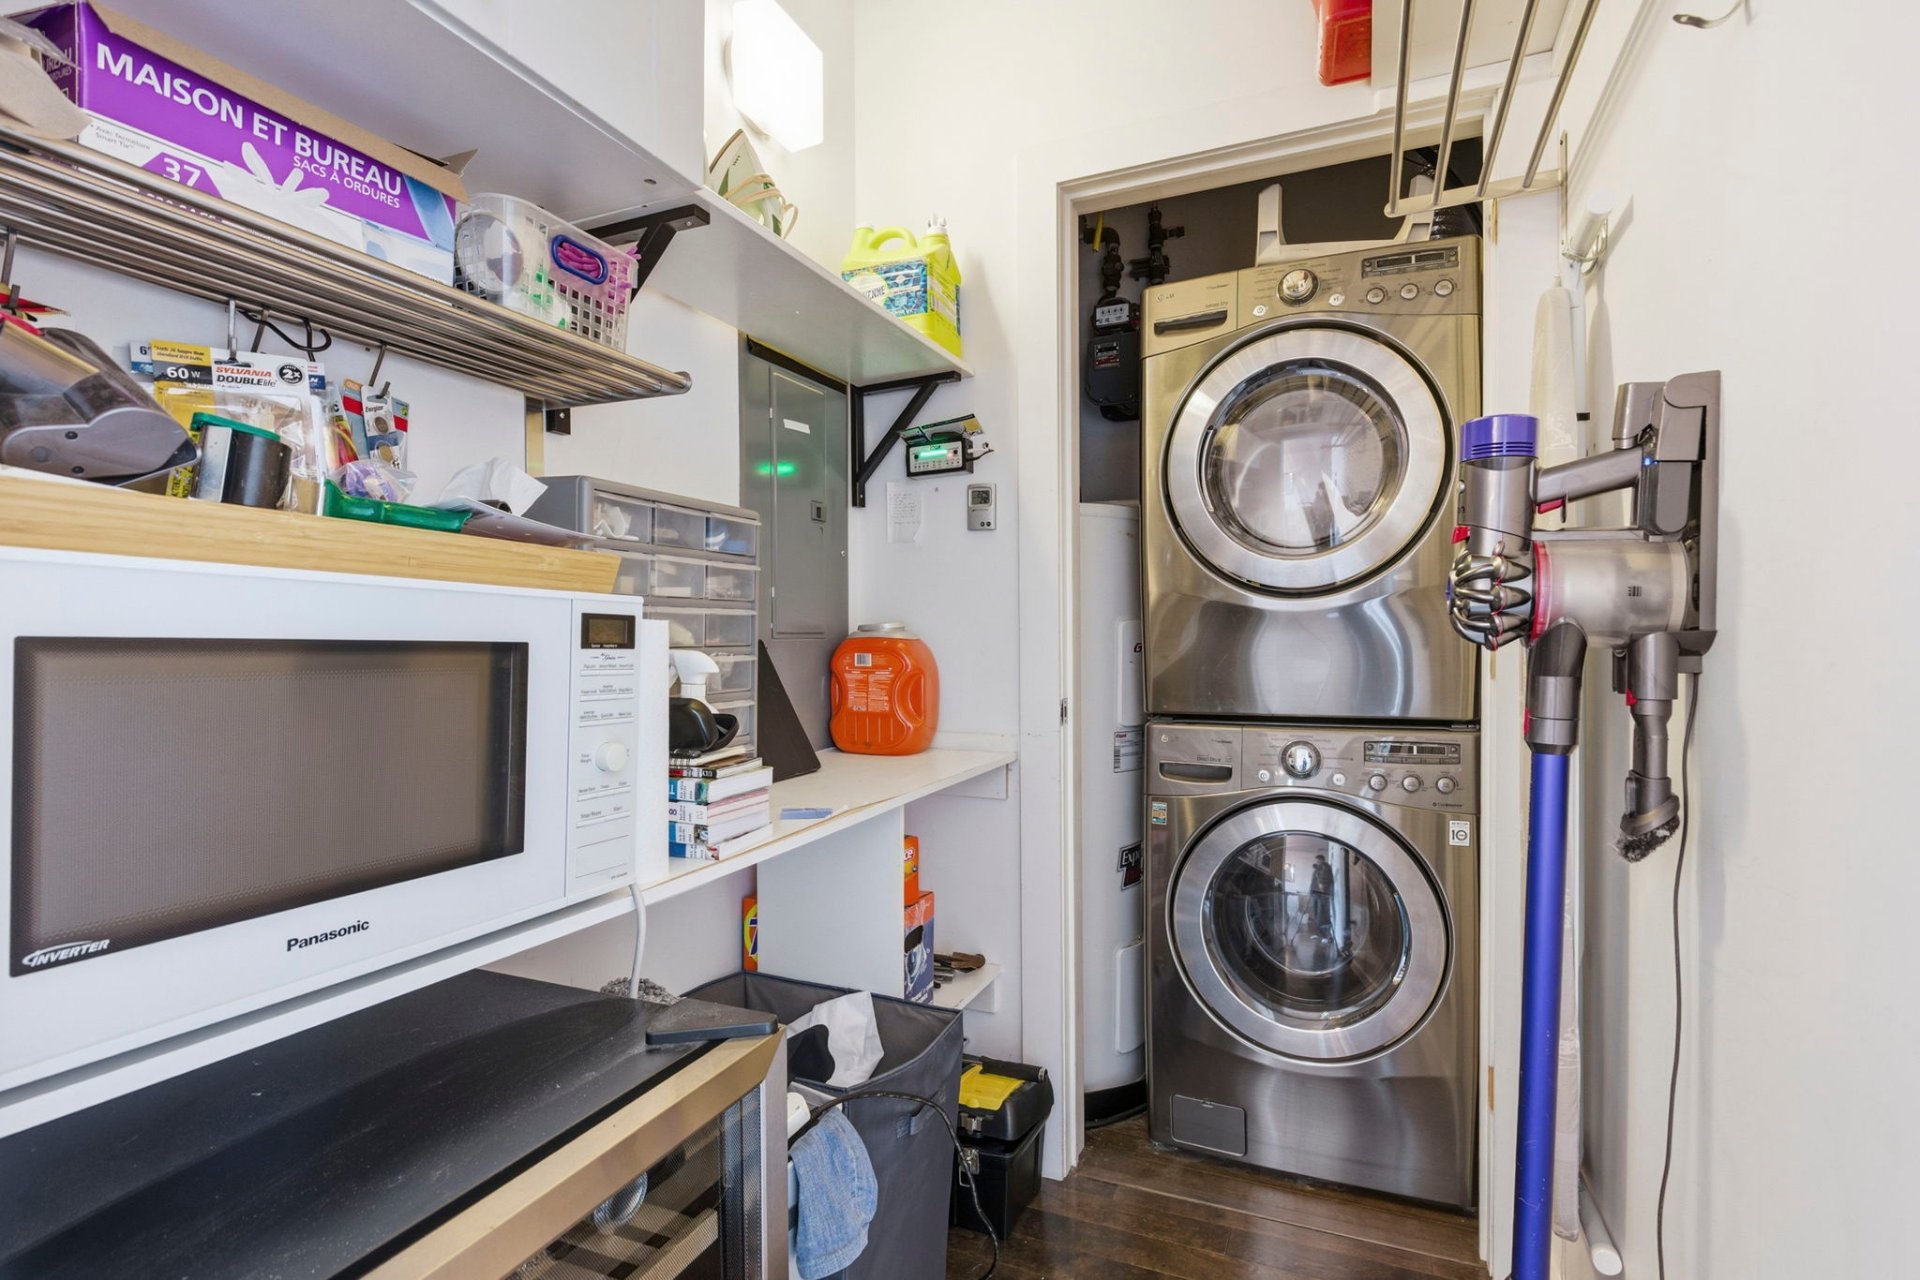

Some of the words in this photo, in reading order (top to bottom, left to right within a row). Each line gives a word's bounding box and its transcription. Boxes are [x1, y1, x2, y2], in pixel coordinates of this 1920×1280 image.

[96, 42, 243, 130] MAISON
[252, 111, 288, 147] ET
[294, 130, 402, 196] BUREAU
[162, 157, 201, 189] 37
[292, 155, 327, 179] SACS
[330, 168, 341, 186] À
[343, 176, 401, 209] ORDURES
[166, 366, 189, 380] 60
[190, 370, 201, 378] W
[215, 366, 272, 378] SYLVANIA
[216, 375, 276, 387] DOUBLElife
[286, 918, 370, 952] Panasonic
[28, 939, 111, 968] INVERTER
